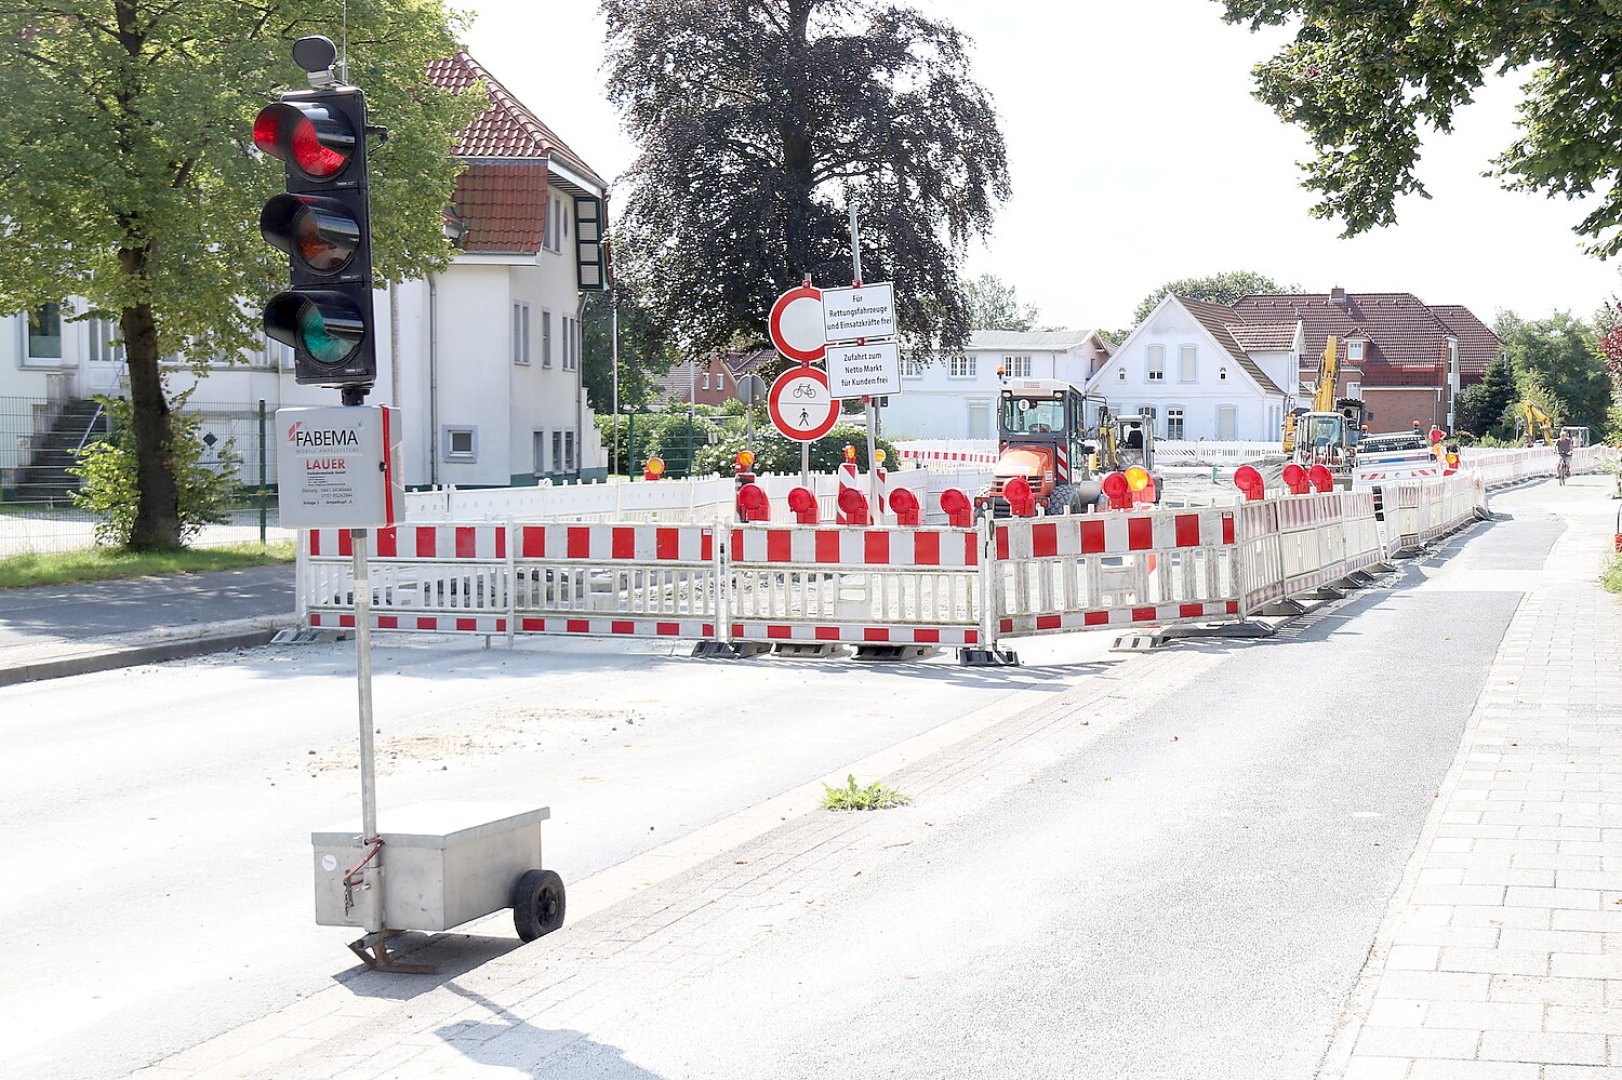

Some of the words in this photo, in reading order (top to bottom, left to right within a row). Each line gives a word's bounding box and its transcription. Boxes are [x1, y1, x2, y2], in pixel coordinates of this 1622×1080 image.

[853, 295, 863, 303] Für
[829, 306, 888, 318] Rettungsfahrzeuge
[827, 322, 839, 331] und
[840, 319, 880, 330] Einsatzkräfte
[881, 317, 892, 325] frei
[844, 353, 867, 362] Zufahrt
[845, 366, 863, 374] Netto
[864, 364, 883, 373] Markt
[841, 379, 851, 387] für
[852, 377, 876, 386] Kunden
[876, 375, 888, 384] frei
[296, 430, 358, 446] FABEMA
[306, 458, 346, 470] LAUER
